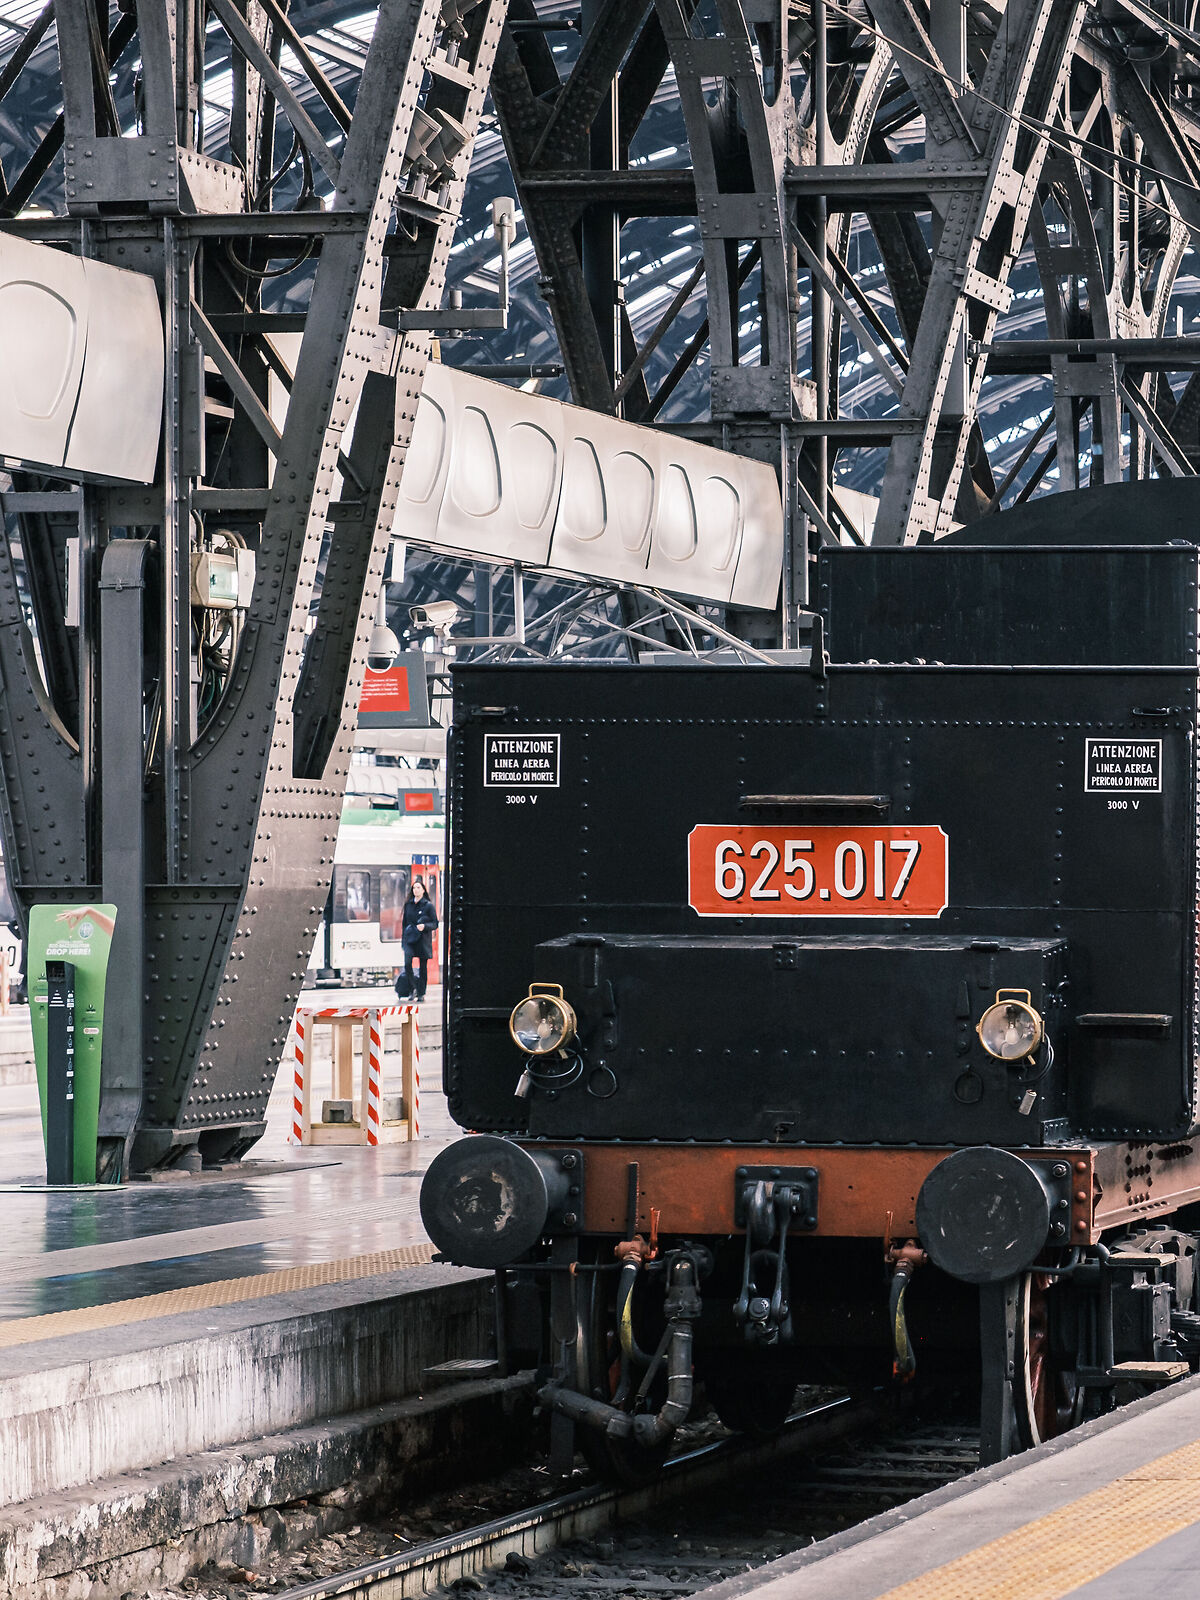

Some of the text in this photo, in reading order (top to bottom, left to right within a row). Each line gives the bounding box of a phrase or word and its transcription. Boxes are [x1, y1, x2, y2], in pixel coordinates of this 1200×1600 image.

[490, 740, 554, 753] ATTENZIONE
[1091, 745, 1156, 758] ATTENZIONE
[494, 759, 550, 768] LINEA AEREA
[1096, 763, 1153, 773] LINEA AEREA
[491, 771, 554, 782] PERICOLO DI MORTE
[1091, 776, 1157, 787] PERICOLO DI MORTE
[505, 795, 538, 804] 3000 V
[1107, 800, 1140, 809] 3000 V
[714, 839, 921, 900] 625.017
[46, 948, 68, 956] DROP
